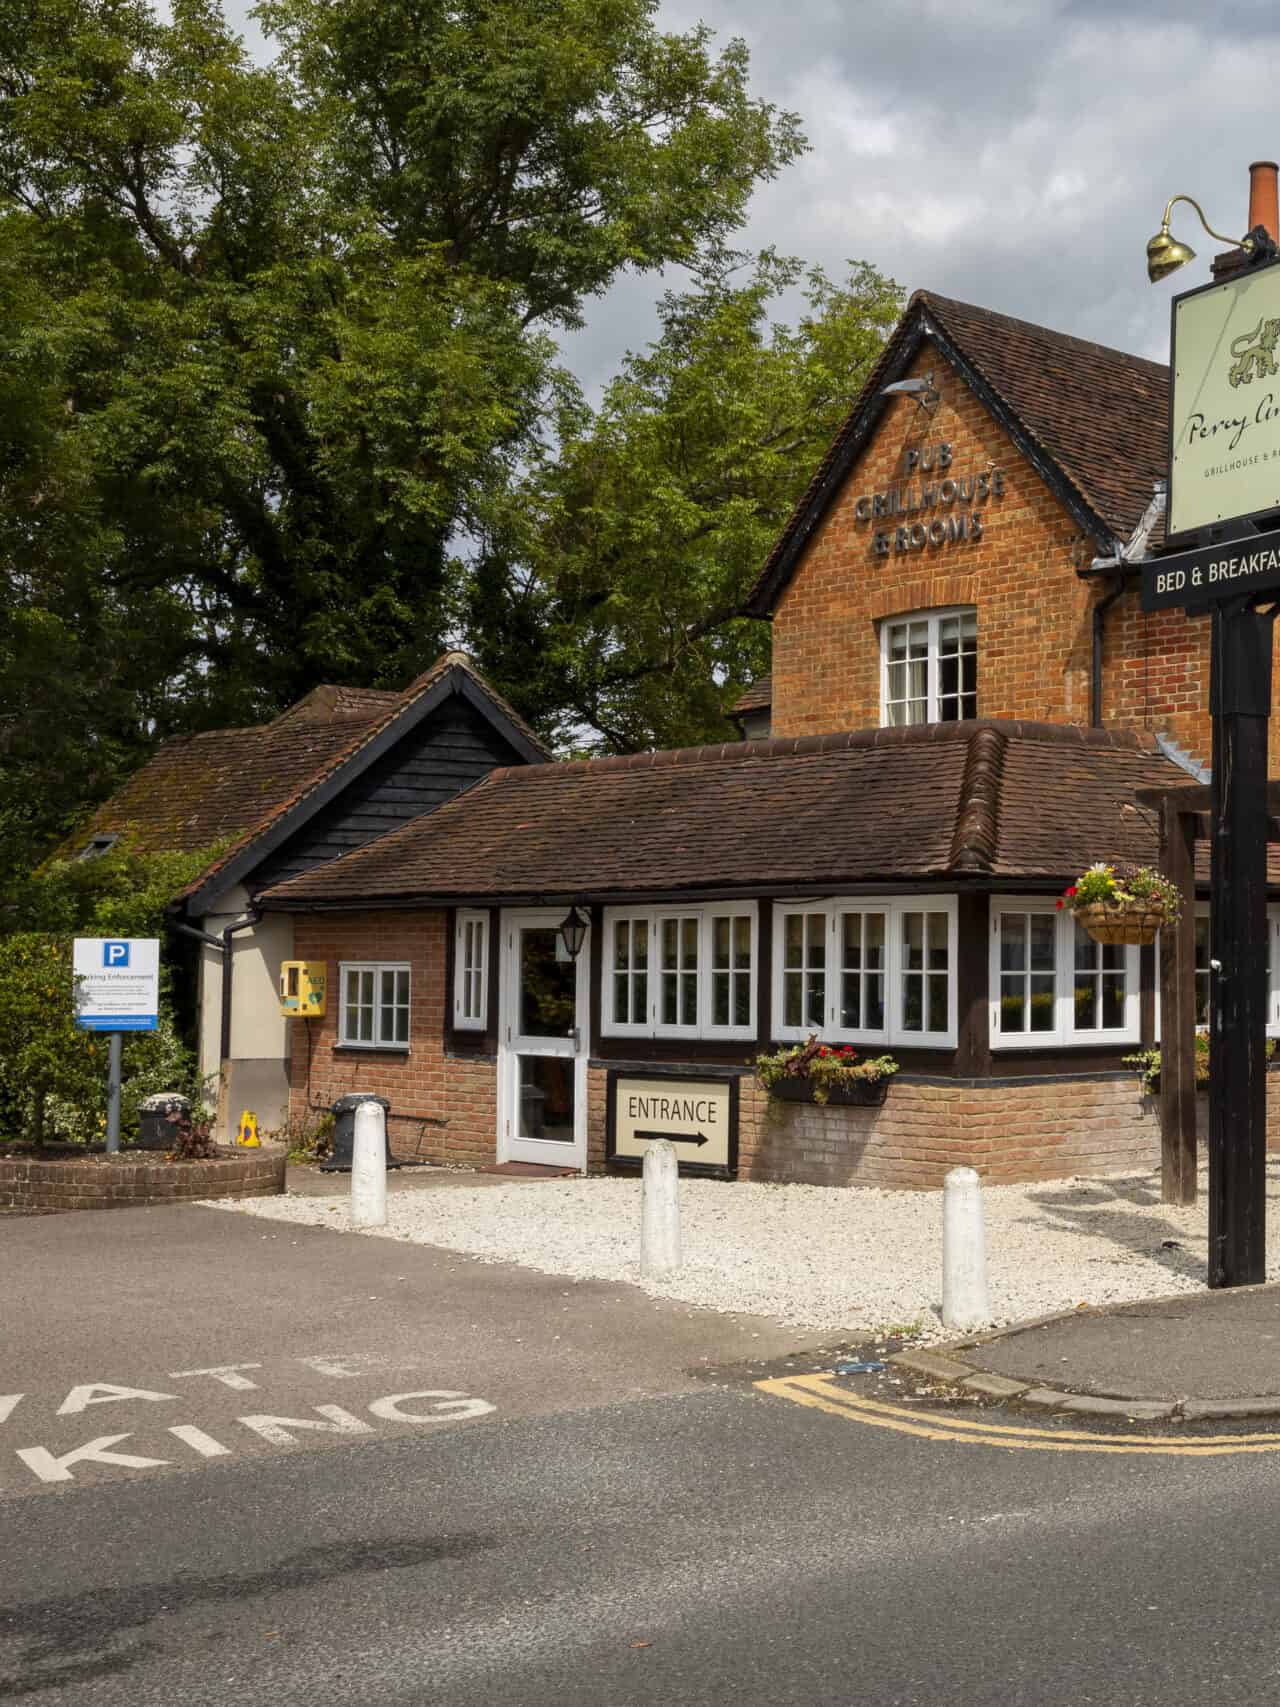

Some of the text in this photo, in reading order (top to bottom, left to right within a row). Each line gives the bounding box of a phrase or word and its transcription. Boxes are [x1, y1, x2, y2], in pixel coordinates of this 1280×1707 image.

[1188, 413, 1251, 450] Percy
[905, 443, 953, 472] PUB
[1204, 454, 1260, 478] GRILLHOUSE
[856, 467, 1007, 521] GRILLHOUSE
[895, 511, 983, 553] ROOMS
[1156, 570, 1186, 593] BED
[1191, 565, 1203, 586] &
[109, 944, 126, 965] P
[628, 1096, 718, 1124] ENTRANCE
[15, 1389, 498, 1482] KING
